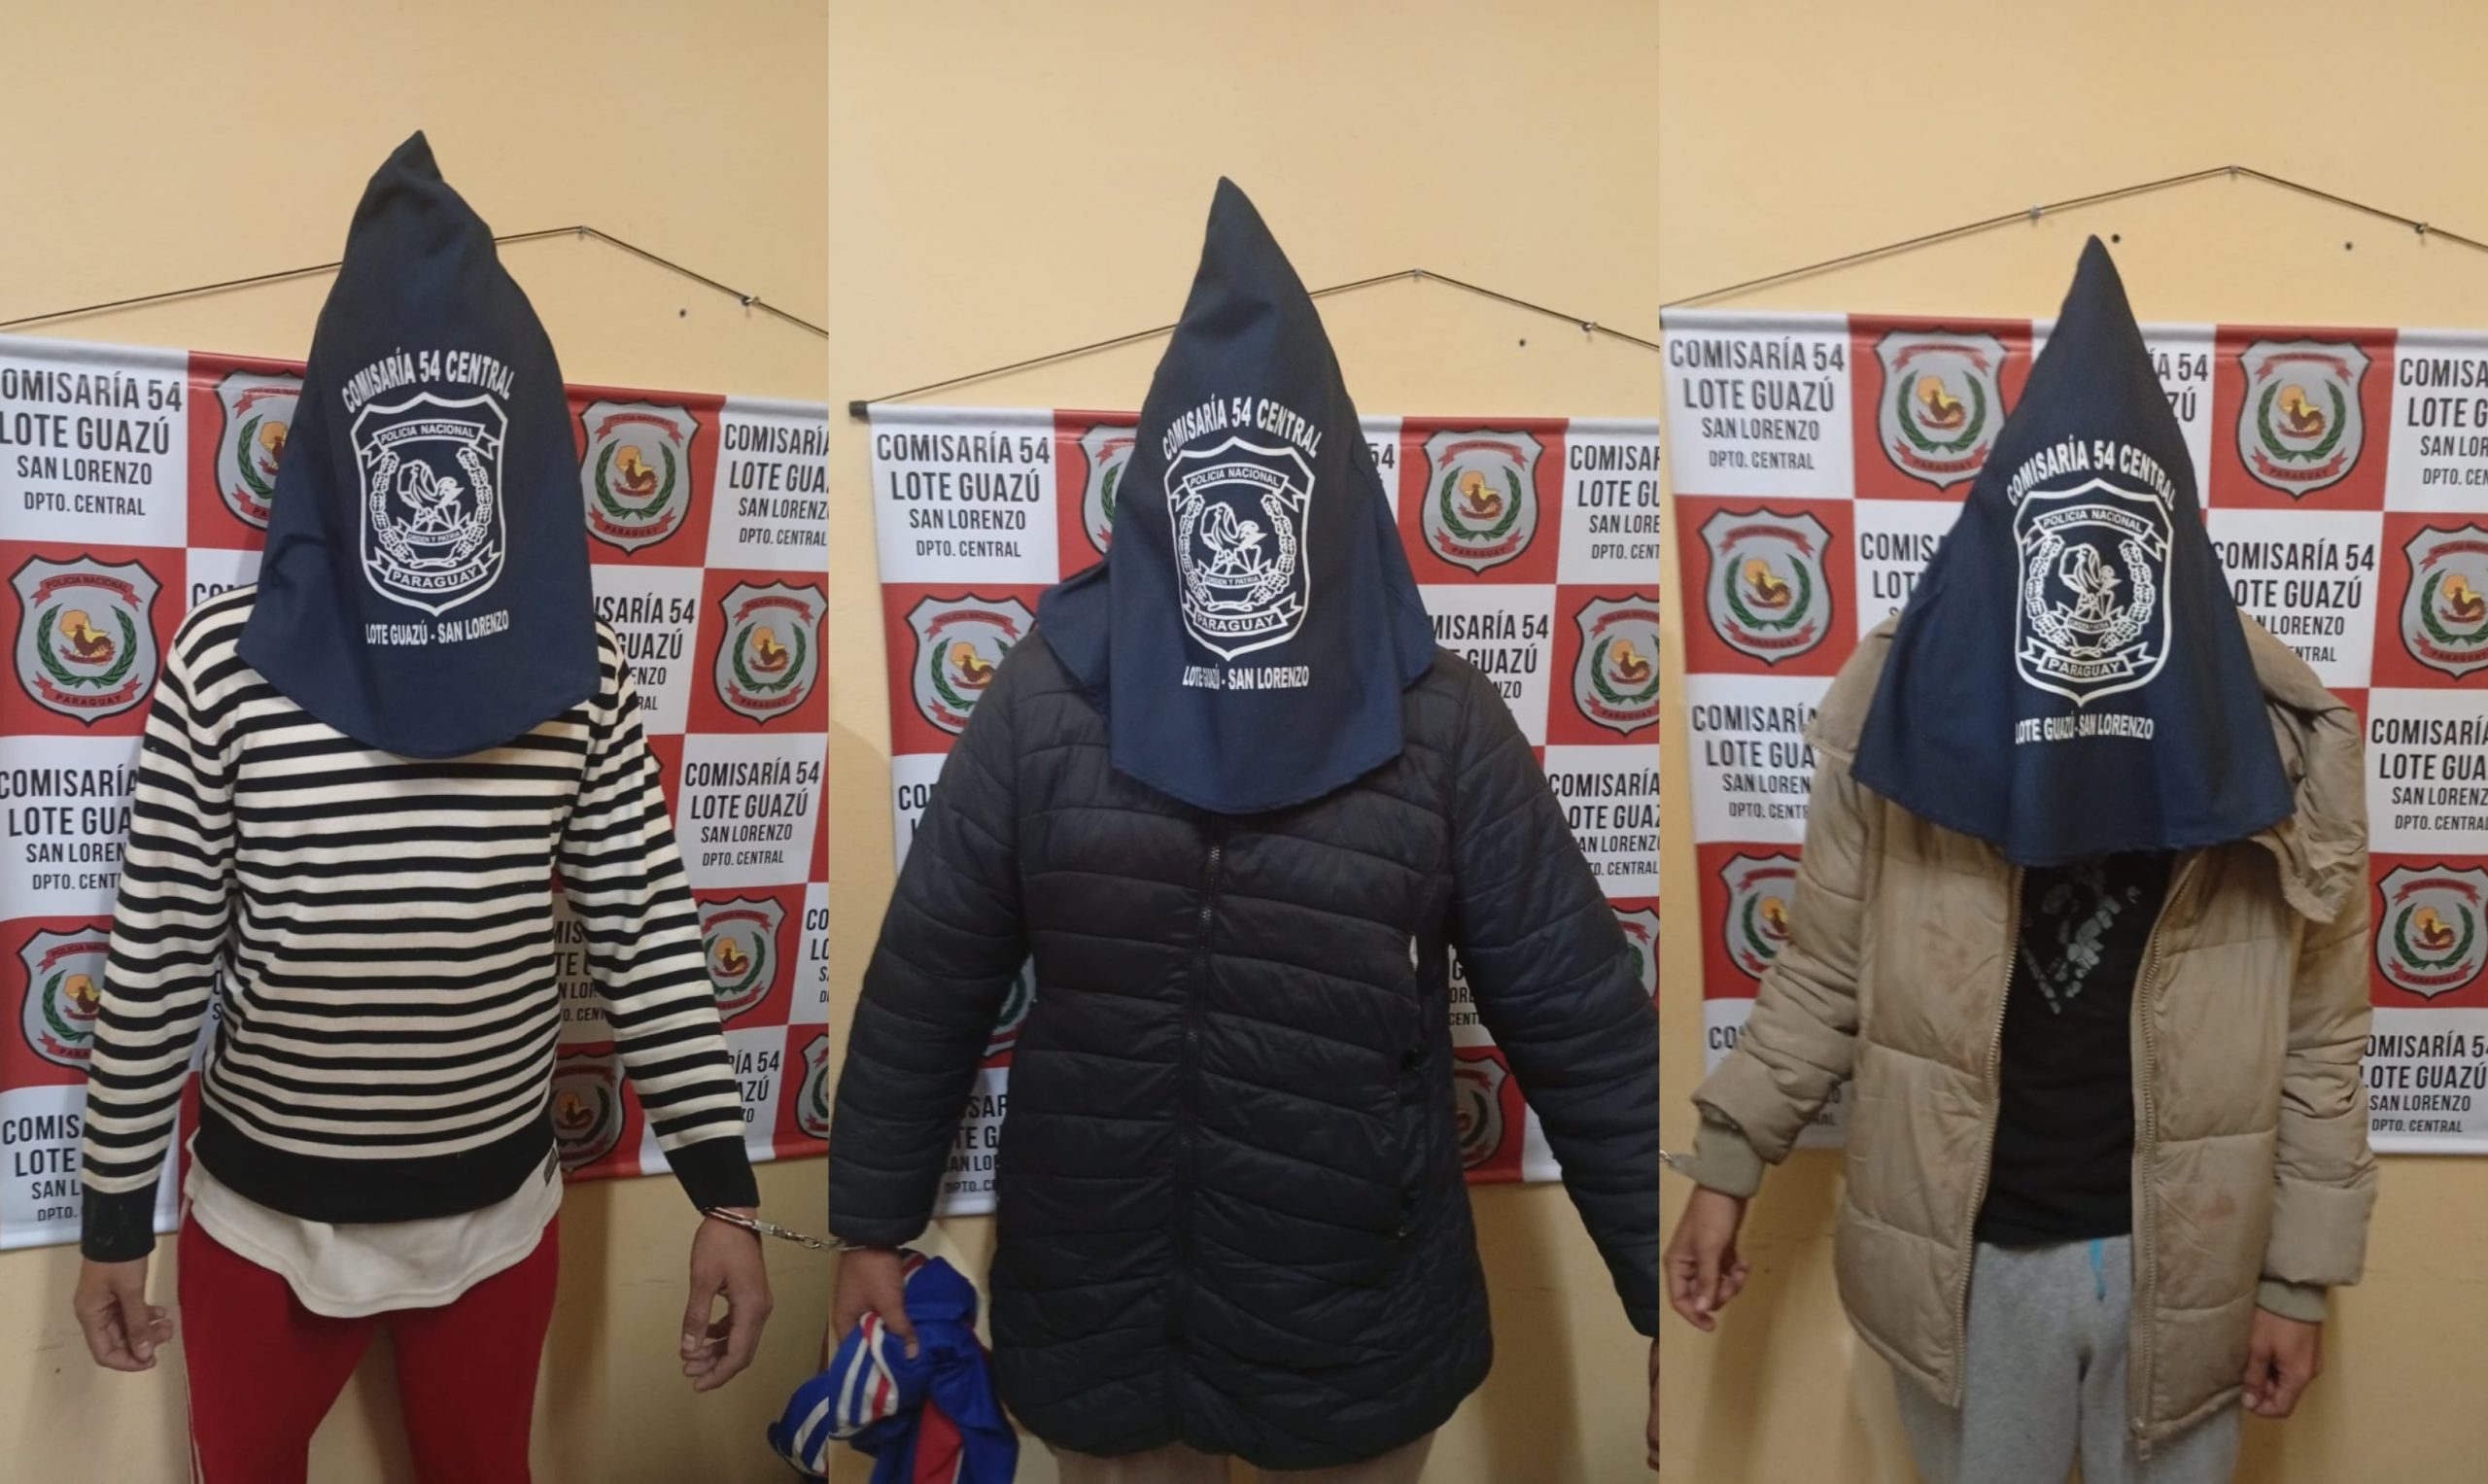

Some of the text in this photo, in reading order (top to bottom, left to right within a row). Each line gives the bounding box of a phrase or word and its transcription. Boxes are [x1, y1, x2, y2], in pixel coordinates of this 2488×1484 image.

[1670, 336, 1845, 372] COMISARÍA 54
[2178, 353, 2208, 382] 54
[2401, 358, 2488, 389] COMISA
[2, 367, 183, 412] OMISARÍA 54
[342, 347, 515, 413] COMISARÍA 54 CENTRAL
[1683, 376, 1835, 412] LOTE GUAZÚ
[2407, 397, 2468, 428] LOTE
[0, 410, 169, 455] LOTE GUAZÚ
[380, 424, 475, 444] POLICIA NACIONAL
[1162, 394, 1322, 461] COMISARÍA 54 CENTRAL
[1702, 417, 1820, 441] SAN LORENZO
[877, 431, 1050, 464] COMISARÍA 54
[2420, 435, 2455, 457] SAN
[17, 455, 153, 485] SAN LORENZO
[1710, 450, 1814, 470] DPTO. CENTRAL
[2007, 433, 2176, 511] COMISARÍA 54 CENTRAL
[729, 461, 828, 494] LOTE GUA
[891, 468, 1040, 502] LOTE GUAZÚ
[1189, 467, 1280, 488] POLICIA NACIONAL
[2423, 468, 2462, 486] DPTO.
[24, 491, 146, 516] DPTO. CENTRAL
[1577, 480, 1632, 507] LOTE
[739, 498, 828, 520] SAN LORENZ
[909, 508, 1026, 530] SAN LORENZO
[2043, 509, 2143, 533] POLICIA NACIONAL
[1589, 514, 1660, 535] SAN LORE
[739, 528, 827, 546] DPTO. CENTRAL
[916, 540, 1021, 558] DPTO. CENTRAL
[1860, 533, 1934, 563] COMIS
[1591, 543, 1628, 560] DPTO.
[2345, 543, 2374, 571] 54
[392, 567, 477, 588] PARAGUAY
[2235, 575, 2362, 608] OTE GUAZÚ
[595, 592, 695, 625] ISARÍA 54
[365, 609, 509, 645] LOTE GUAZÚ SAN LORENZO
[1196, 614, 1275, 632] PARAGUAY
[1429, 609, 1549, 639] MISARÍA 54
[2270, 615, 2344, 636] LORENZO
[2291, 646, 2336, 662] NTRAL
[631, 667, 667, 685] ENZO
[1228, 668, 1254, 690] SAN
[1258, 666, 1309, 690] LORENZO
[2048, 657, 2122, 677] PARAGUAY
[2044, 710, 2075, 742] GUAZÚ
[2079, 713, 2097, 738] SAN
[2097, 713, 2155, 741] LORENZO
[1705, 740, 1815, 769] LOTE GUA
[685, 757, 820, 787] COMISARÍA 54
[2379, 753, 2486, 781] LOTE GUA
[1722, 774, 1811, 795] SAN LOREN
[2392, 786, 2488, 807] SAN LORENZ
[690, 788, 809, 819] LOTE GUAZÚ
[1729, 802, 1765, 819] DPTO.
[9, 807, 131, 837] LOTE GUA
[1569, 804, 1659, 829] OTE GUA
[2395, 815, 2431, 831] DPTO.
[701, 824, 793, 843] SAN LORENZO
[1579, 835, 1659, 853] AN LORENZ
[26, 842, 126, 863] SAN LOREN
[702, 850, 784, 866] DPTO. CENTRAL
[1607, 861, 1659, 876] CENTRAL
[32, 873, 121, 890] DPTO. CENT
[2365, 1030, 2466, 1057] OMISARÍA
[757, 1051, 780, 1072] 54
[2416, 1061, 2487, 1089] GUAZÚ
[2369, 1094, 2471, 1112] SAN LORENZO
[2, 1115, 81, 1145] COMIS
[2371, 1119, 2464, 1133] DPTO. CENTRAL
[15, 1148, 76, 1177] LOTE
[31, 1180, 66, 1199] SAN
[37, 1206, 79, 1222] DPTO.
